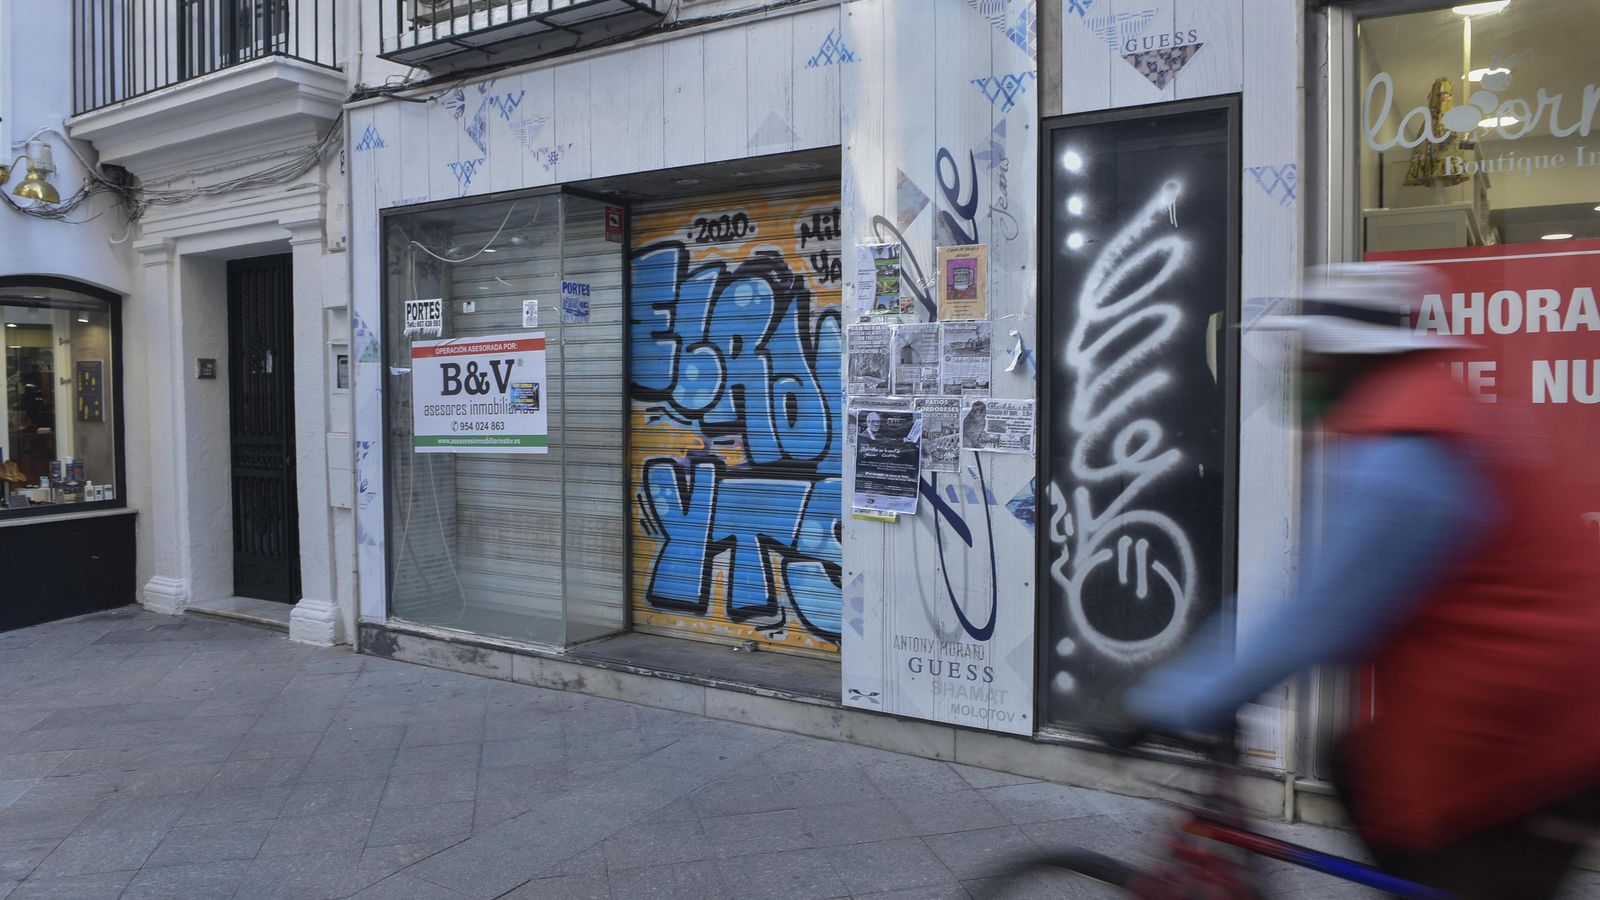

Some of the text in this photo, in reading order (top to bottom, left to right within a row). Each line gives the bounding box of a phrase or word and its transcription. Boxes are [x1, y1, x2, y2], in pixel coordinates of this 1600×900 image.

[1125, 29, 1198, 52] GUESS
[1443, 151, 1564, 176] Boutique
[562, 281, 591, 297] PORTES
[406, 301, 440, 320] PORTES
[468, 344, 502, 353] ASESORADA
[440, 359, 515, 396] B&V
[424, 403, 467, 417] asesores
[460, 421, 505, 431] 954 024 863
[893, 634, 935, 654] ANTONY
[908, 657, 994, 684] GUESS
[951, 704, 1016, 723] MOLOTOV
